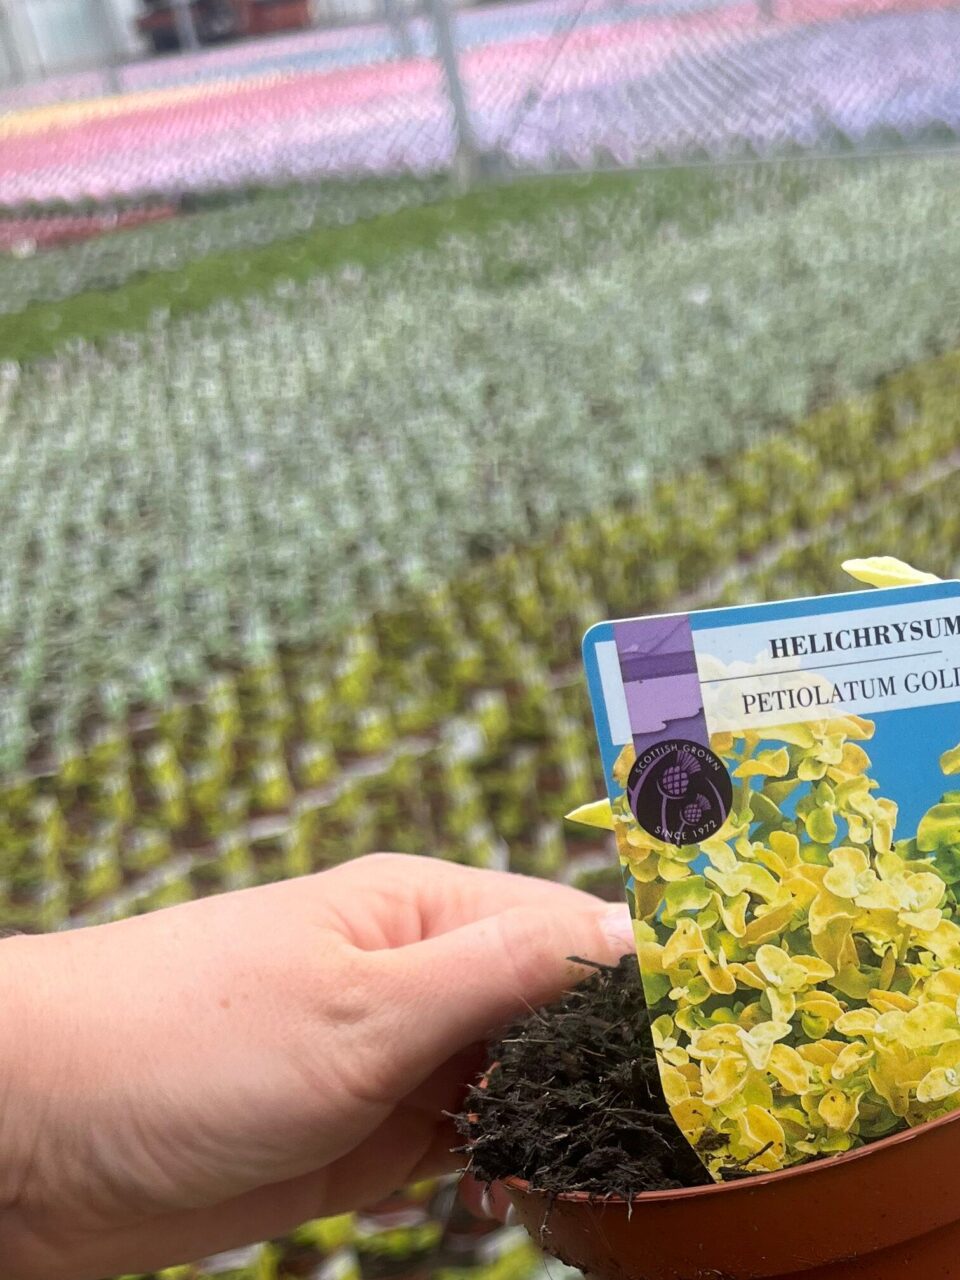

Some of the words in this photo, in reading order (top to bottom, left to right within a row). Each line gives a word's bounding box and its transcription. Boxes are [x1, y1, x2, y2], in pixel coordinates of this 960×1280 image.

[742, 674, 897, 715] PETIOLATUM
[635, 743, 678, 774] SCOTTISH
[682, 744, 721, 771] GROWN
[654, 825, 687, 840] SINCE
[692, 820, 718, 838] 1972
